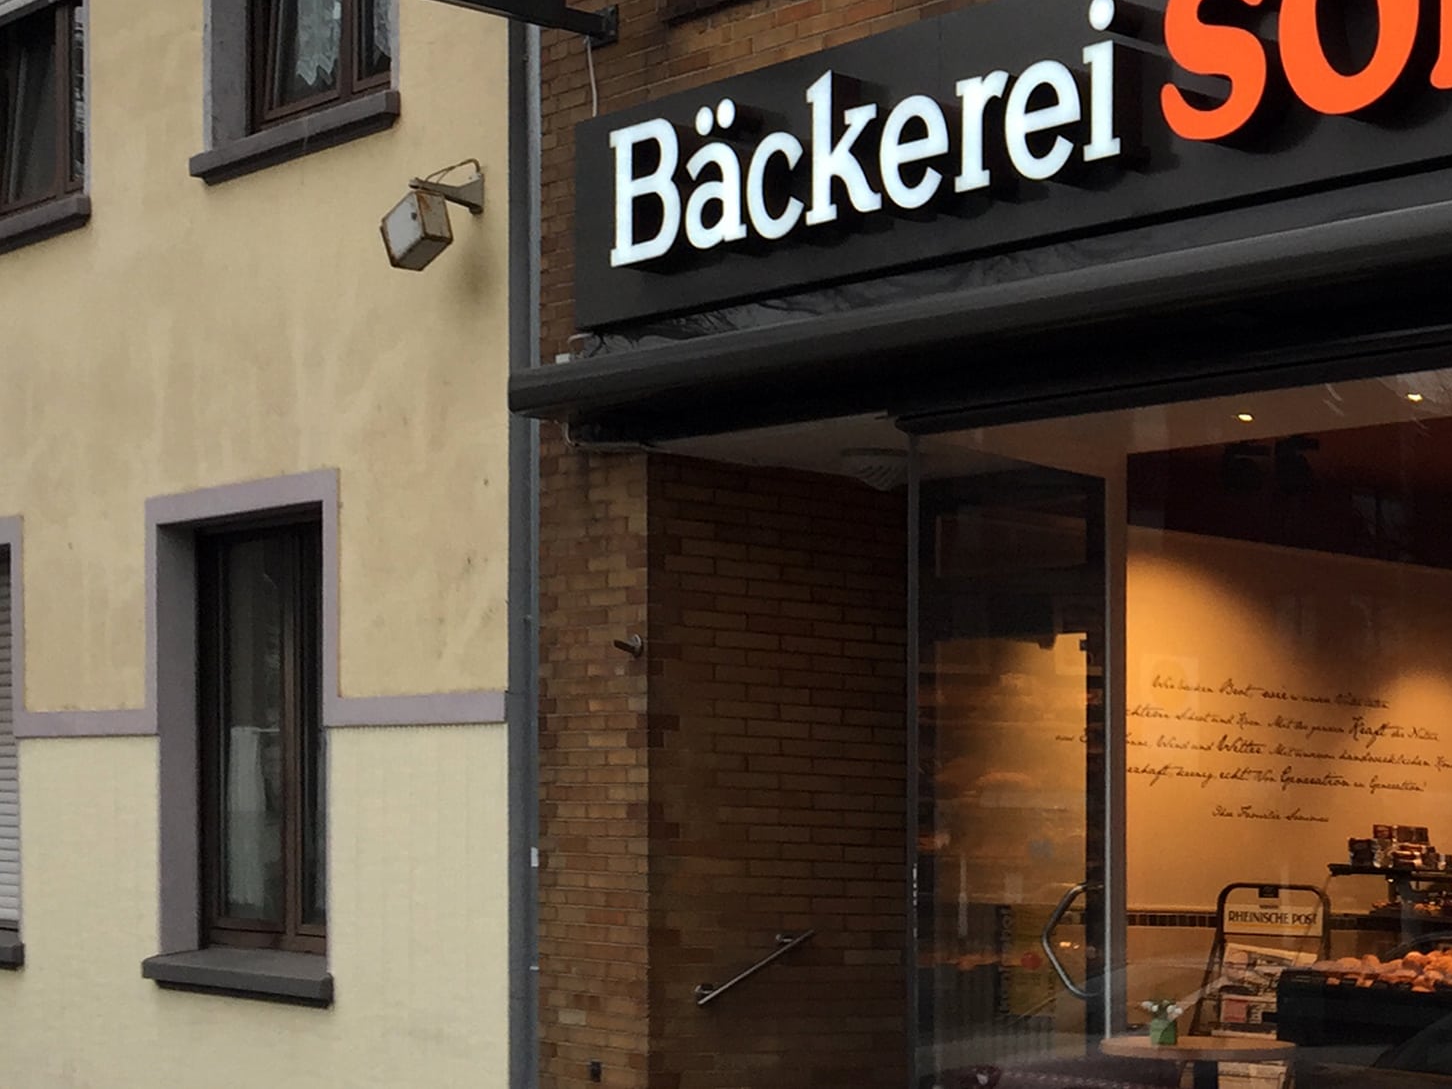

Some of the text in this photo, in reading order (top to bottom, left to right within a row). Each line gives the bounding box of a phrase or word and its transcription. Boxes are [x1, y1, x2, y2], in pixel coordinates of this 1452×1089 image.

[1280, 765, 1350, 791] Generation
[1228, 910, 1318, 925] RHEINISCHE POST
